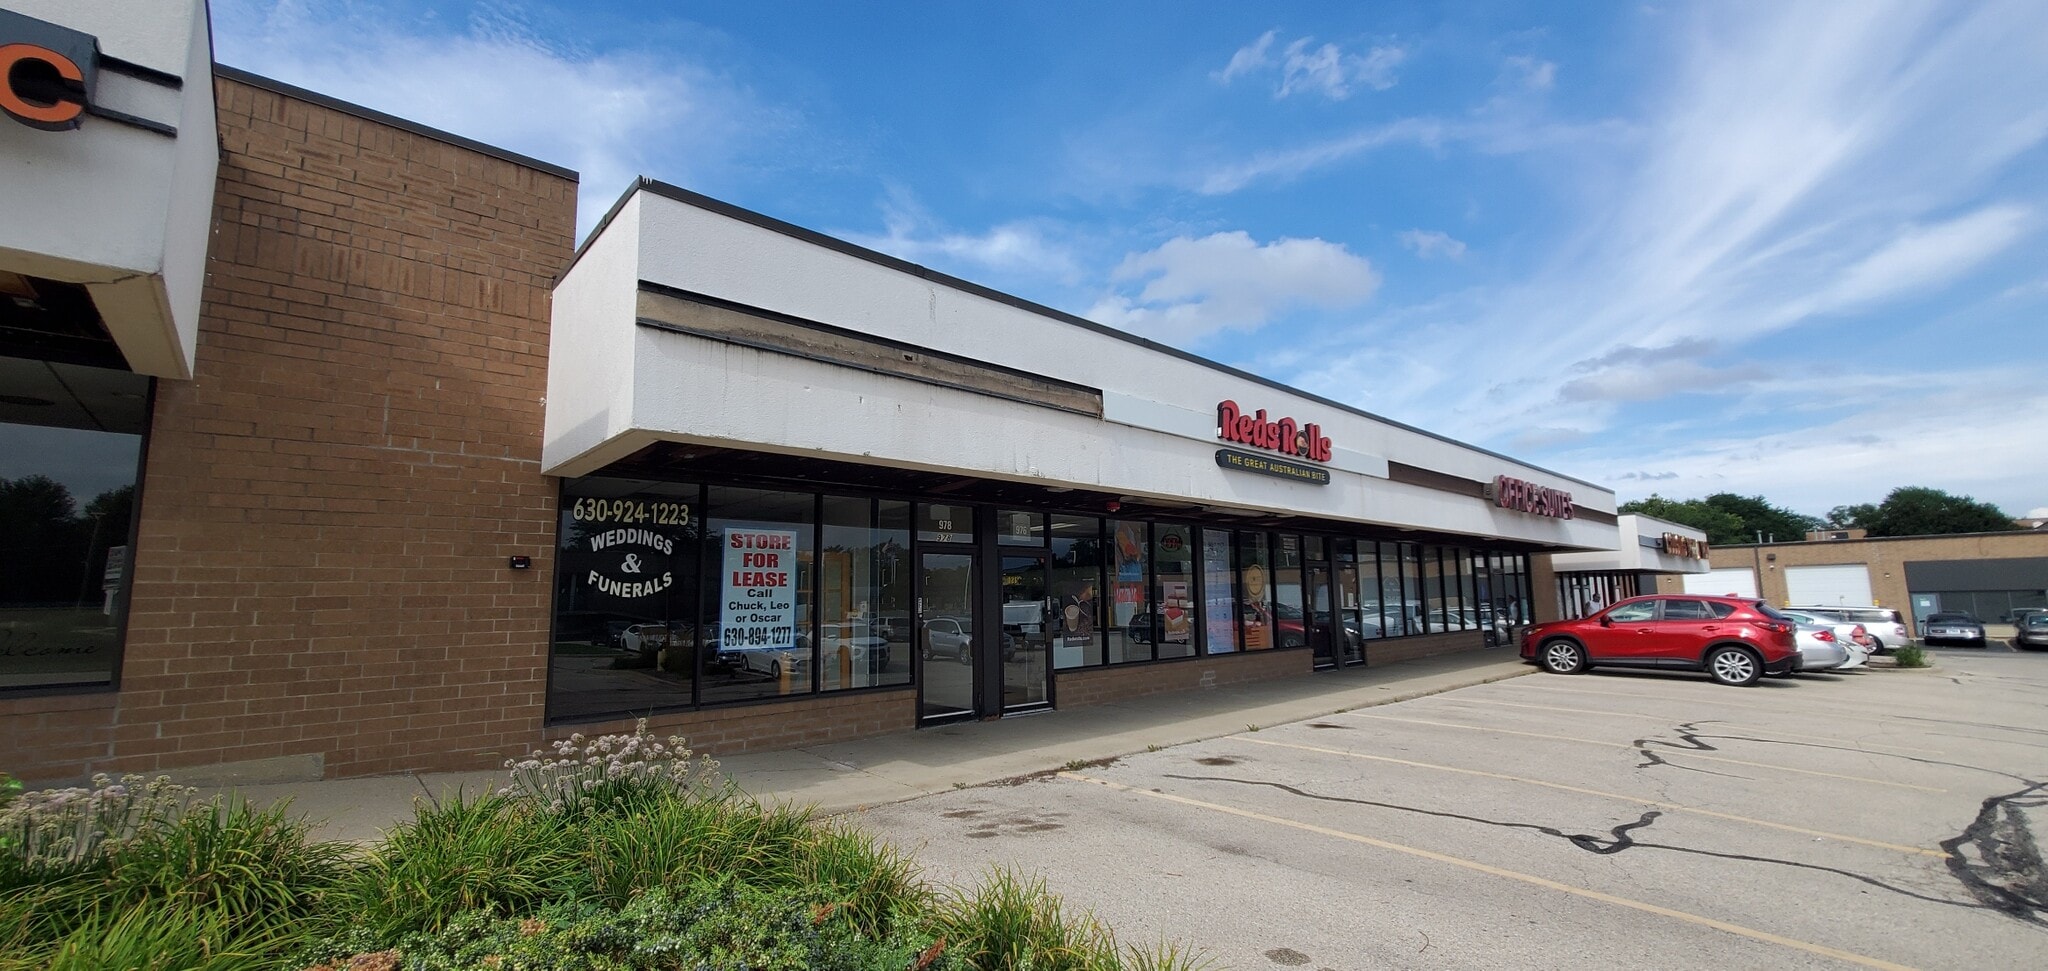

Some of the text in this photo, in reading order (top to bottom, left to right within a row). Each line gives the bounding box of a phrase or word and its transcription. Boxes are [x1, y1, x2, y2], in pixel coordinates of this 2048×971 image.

[1218, 400, 1279, 449] Reds
[1227, 454, 1326, 481] THE GREAT AUSTRALIAN BITE
[1498, 475, 1575, 520] OFFICE SUITES
[572, 498, 689, 526] 630-924-1223
[938, 519, 952, 530] 978
[1015, 525, 1028, 536] 976
[590, 528, 673, 555] WEDDINGS
[730, 533, 791, 550] STORE
[620, 553, 642, 573] &
[743, 552, 779, 569] FOR
[587, 570, 673, 598] FUNERALS
[732, 571, 788, 588] LEASE
[747, 588, 773, 598] Call
[728, 600, 790, 612] Chuck, Leo
[735, 612, 782, 623] or Oscar
[724, 626, 791, 647] 630-894-1277
